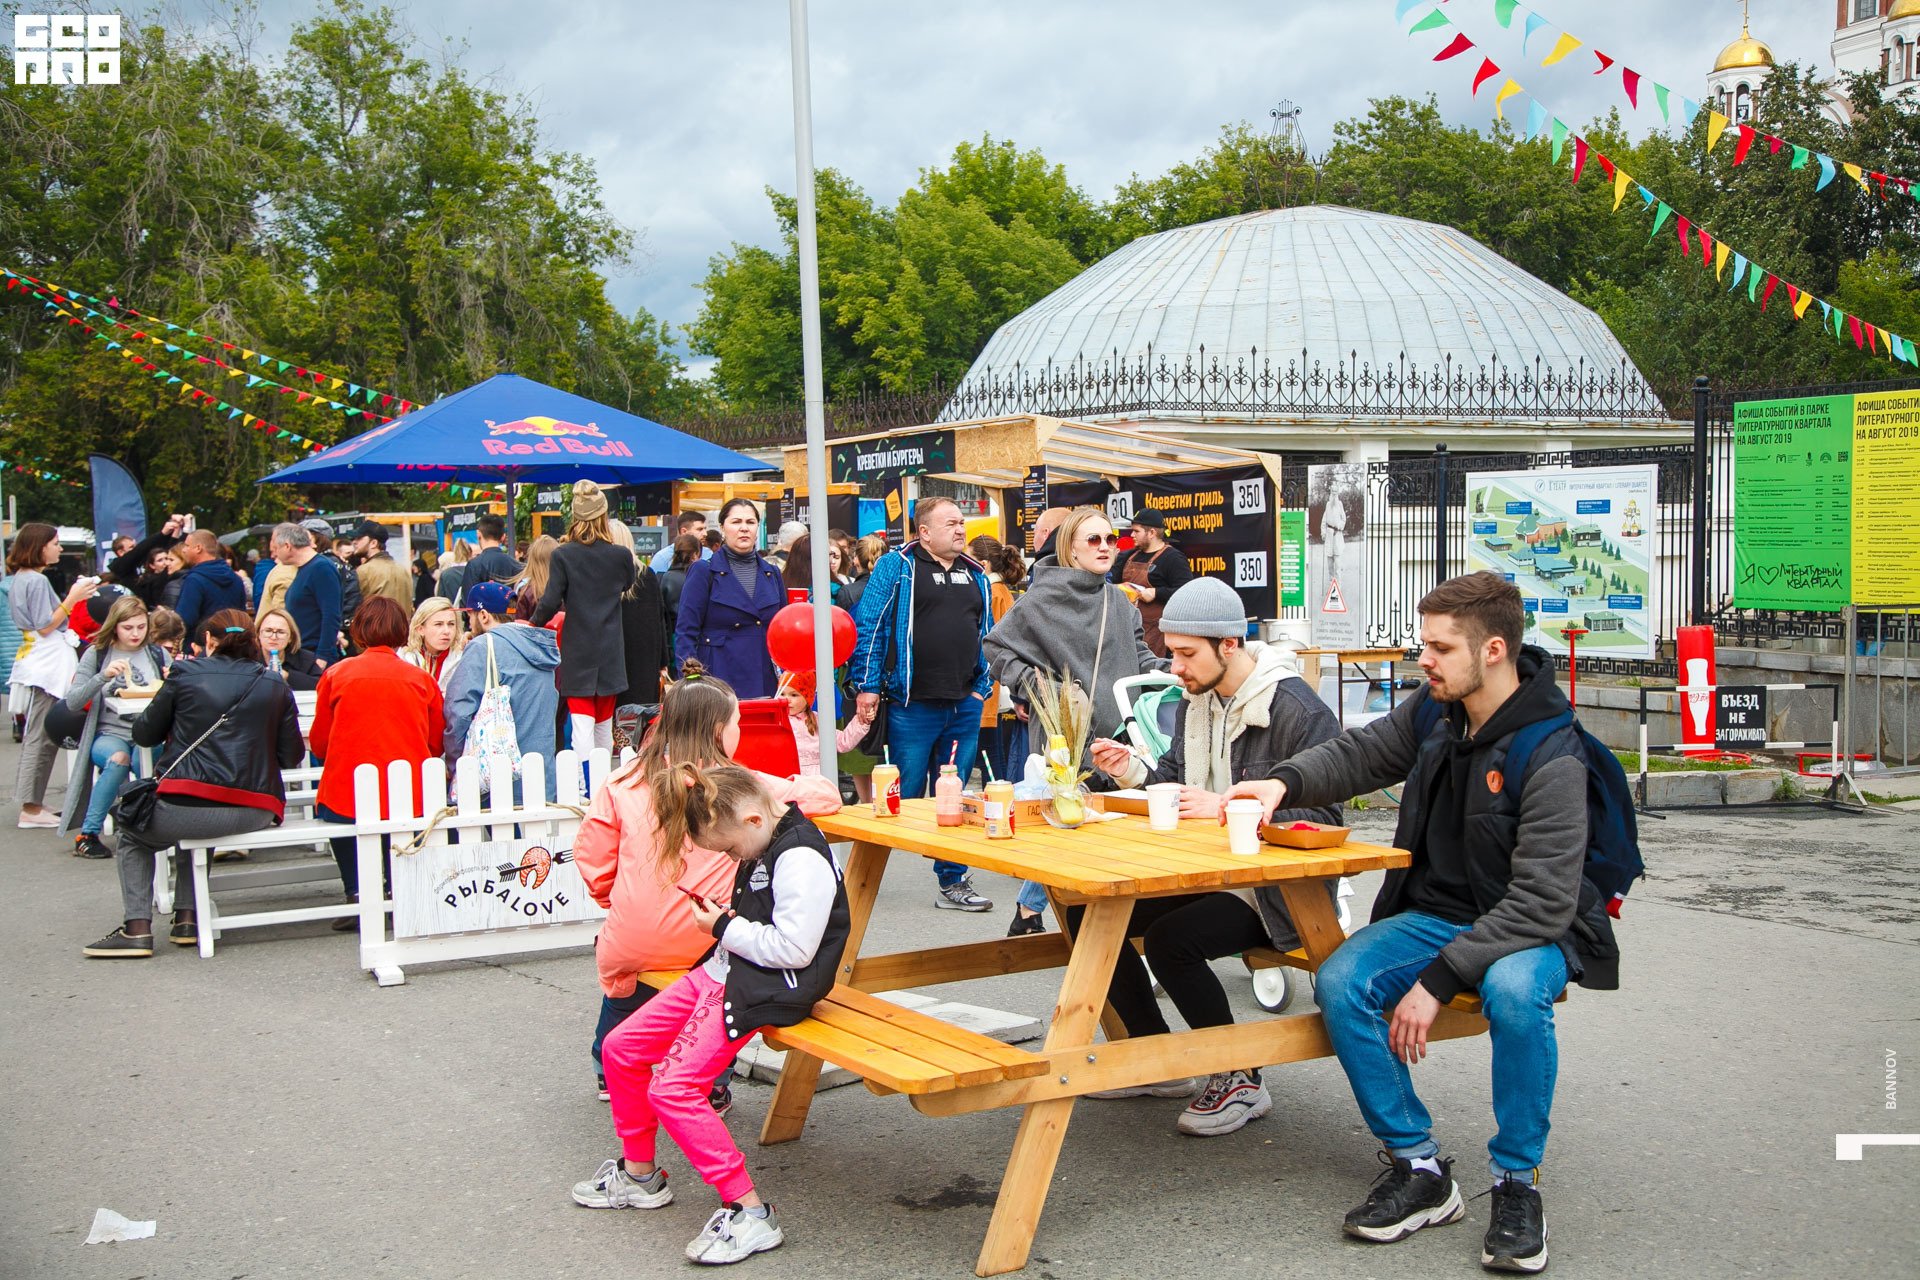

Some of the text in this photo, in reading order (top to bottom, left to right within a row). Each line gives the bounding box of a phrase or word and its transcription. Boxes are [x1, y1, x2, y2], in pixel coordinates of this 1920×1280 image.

[1737, 403, 1830, 419] АФИША СОБЫТИЙ В ПАРКЕ
[1857, 397, 1920, 411] АФИША СОБЫТИ
[1737, 417, 1832, 432] ЛИТЕРАТУРНОГО КВАРТАЛА
[1856, 411, 1920, 426] ЛИТЕРАТУРНОГО
[1737, 433, 1792, 446] НА АВГУСТ 2019
[1856, 426, 1919, 440] НА АВГУСТ 2019
[481, 437, 634, 457] Red Bull
[857, 447, 924, 471] КРЕВЕТКИ И БУРГЕРЫ
[1194, 490, 1225, 511] гриль
[1239, 484, 1260, 509] 350
[1164, 513, 1223, 536] усом карри
[1196, 557, 1226, 577] гриль
[1240, 557, 1262, 582] 350
[1740, 562, 1755, 585] Я
[1786, 576, 1843, 590] КВАРТАЛ
[1721, 694, 1760, 710] ВЪЕЗД
[1728, 712, 1747, 724] НЕ
[1715, 728, 1767, 742] ЗАГОРАЖИВАТЬ
